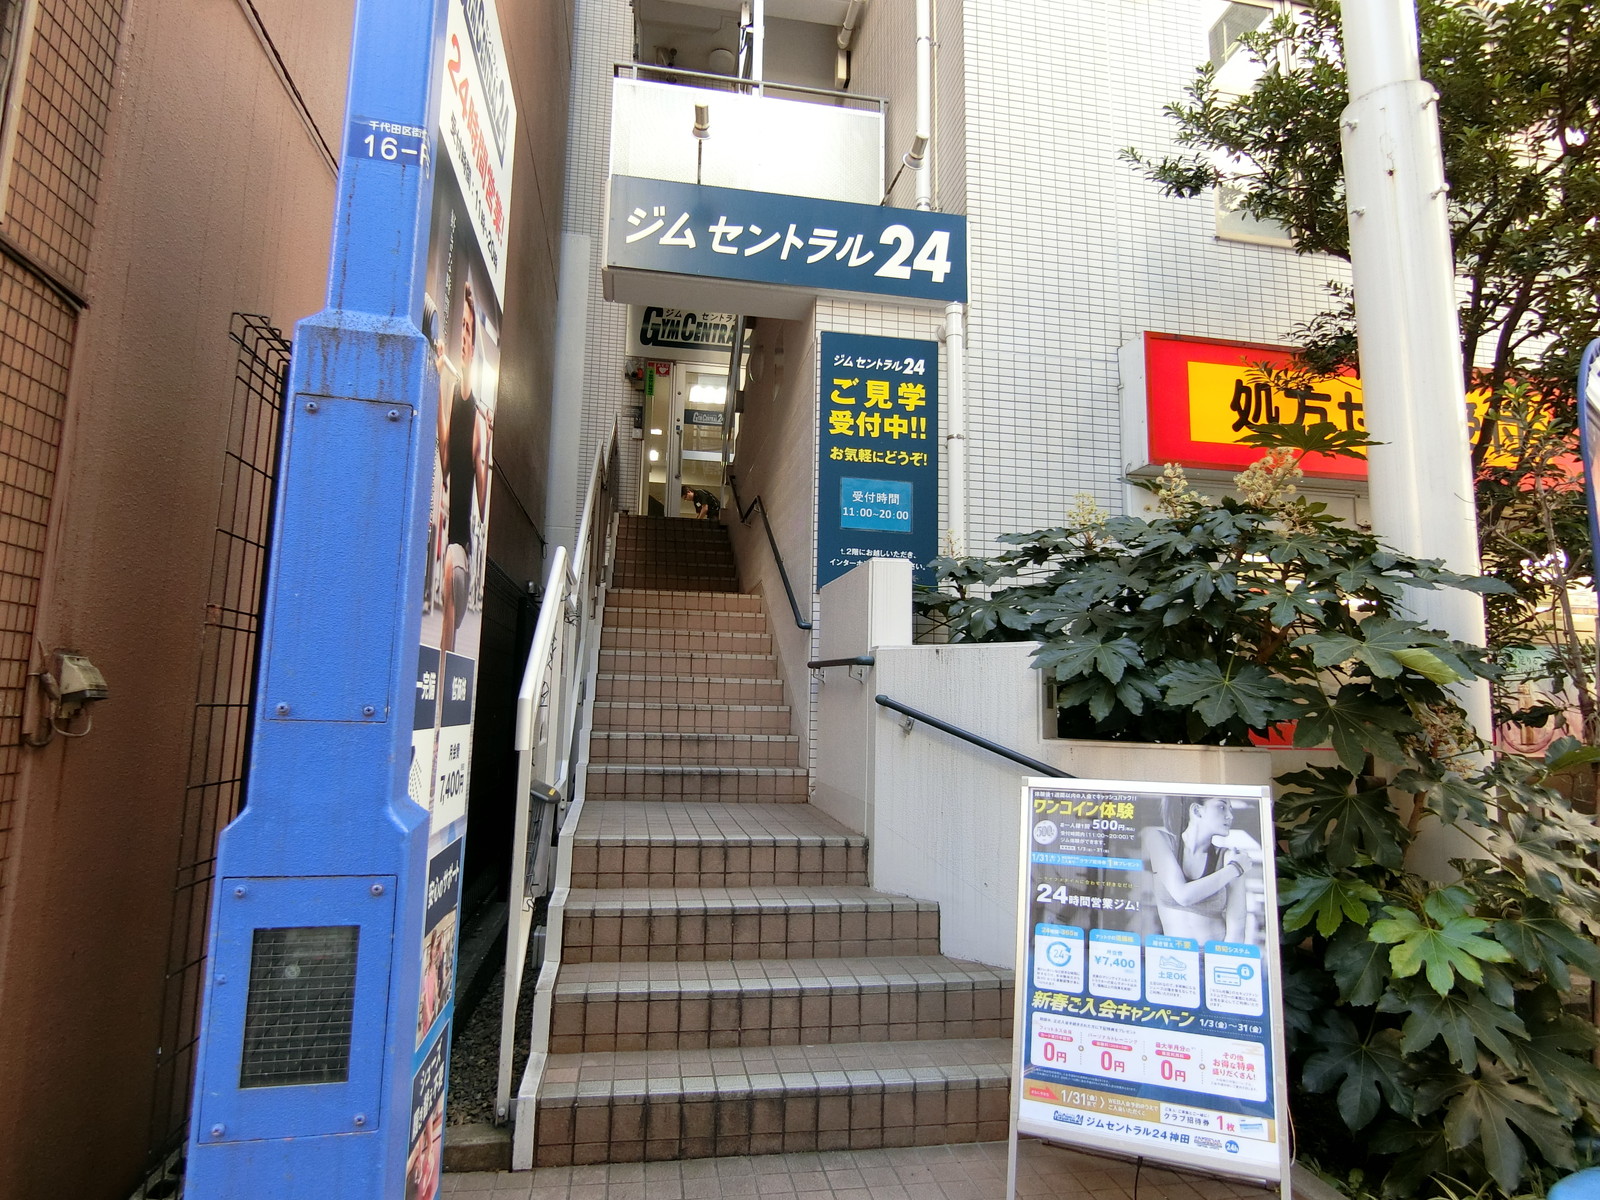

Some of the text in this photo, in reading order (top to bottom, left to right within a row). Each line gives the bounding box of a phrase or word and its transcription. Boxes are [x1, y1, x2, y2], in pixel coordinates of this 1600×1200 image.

[625, 206, 696, 249] ジム
[640, 306, 680, 345] GYM
[834, 354, 853, 367] ジム
[830, 377, 926, 412] ご見学
[829, 410, 927, 439] 受付中!!
[830, 446, 928, 466] お気軽にどうぞ!
[852, 491, 900, 505] 受付時間
[1033, 799, 1135, 820] ワンコイン体験
[428, 860, 460, 910] 安心のサポート
[1036, 883, 1140, 911] 24時間営業ジム!
[1094, 956, 1135, 969] ¥7,400
[1158, 971, 1187, 981] 土足OK
[1032, 990, 1195, 1028] 新春ご入会キャンペーン
[1044, 1042, 1066, 1063] 0円
[1101, 1051, 1125, 1073] 0円
[1161, 1060, 1186, 1082] 0円
[1163, 1112, 1210, 1127] クラブ招待券
